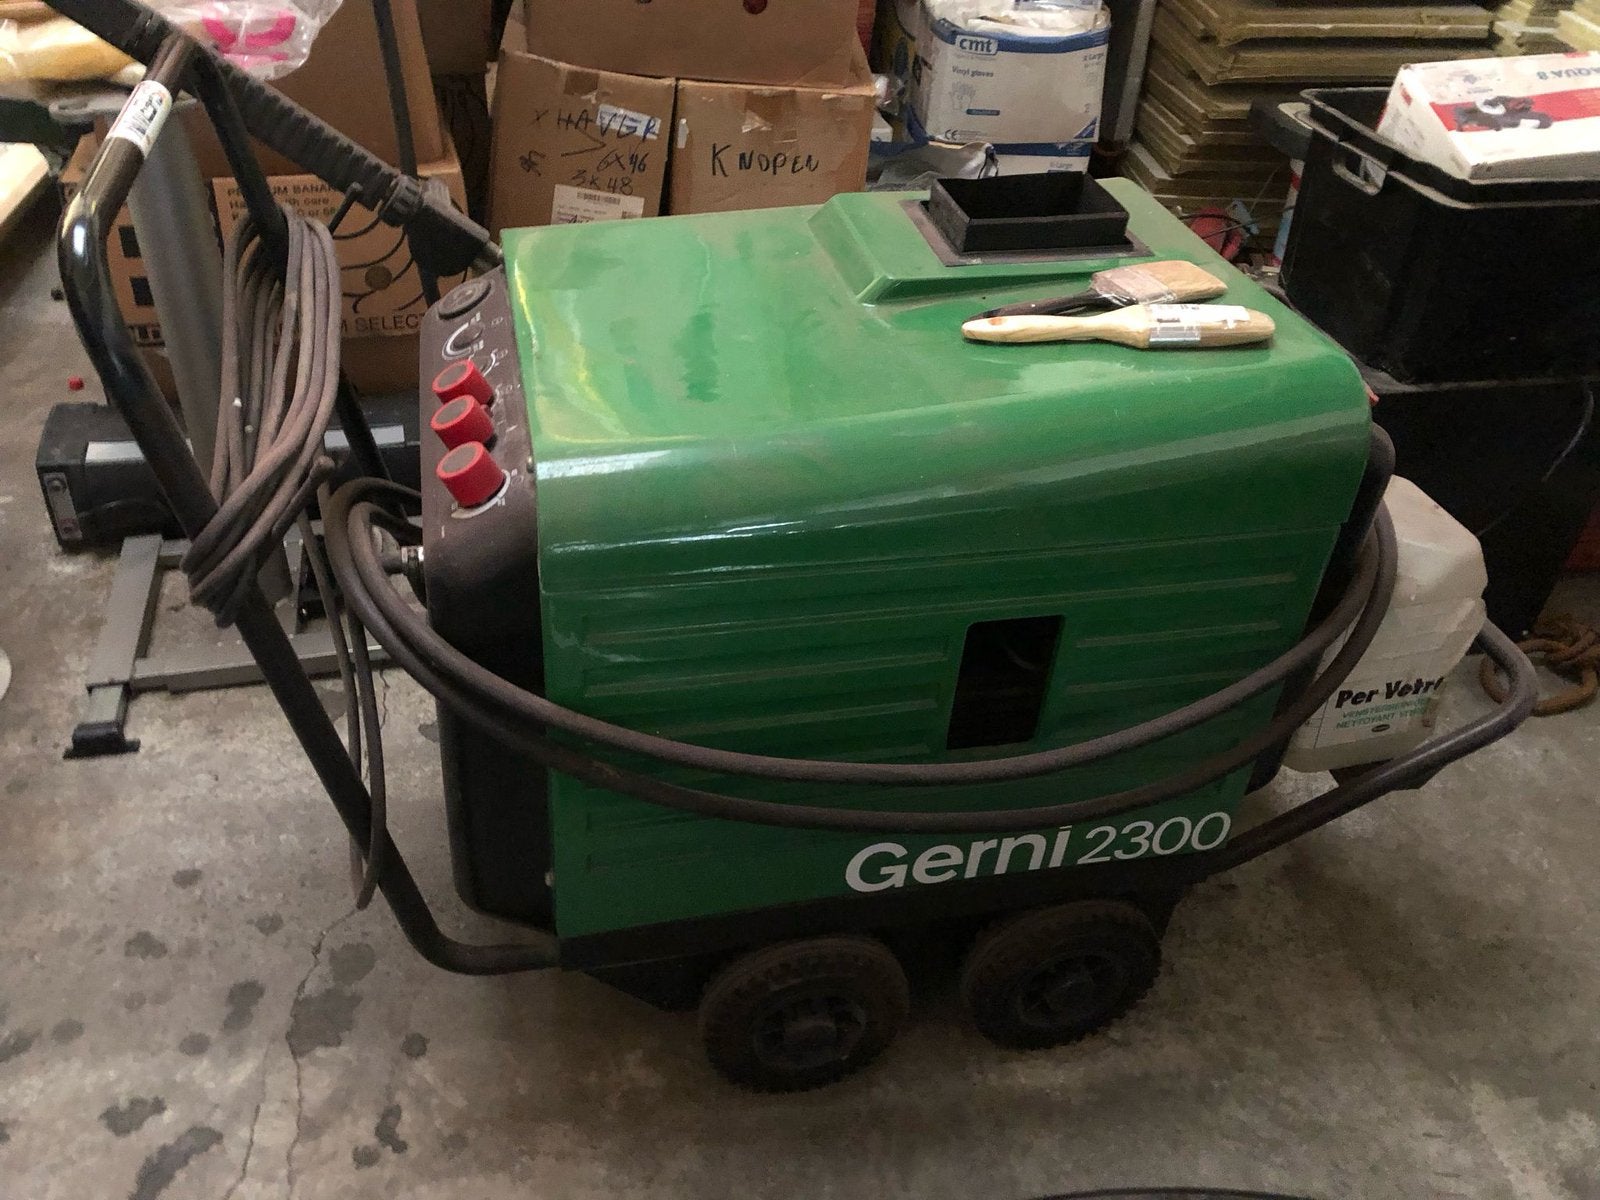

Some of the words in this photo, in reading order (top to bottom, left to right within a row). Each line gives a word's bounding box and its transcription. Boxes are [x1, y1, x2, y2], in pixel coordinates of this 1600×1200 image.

[959, 38, 992, 53] cmt
[951, 65, 970, 77] Vinyl
[970, 69, 994, 79] gloves
[354, 312, 424, 332] SELEC
[1335, 689, 1379, 709] Per
[845, 825, 1073, 893] Gerni
[1077, 811, 1232, 865] 2300
